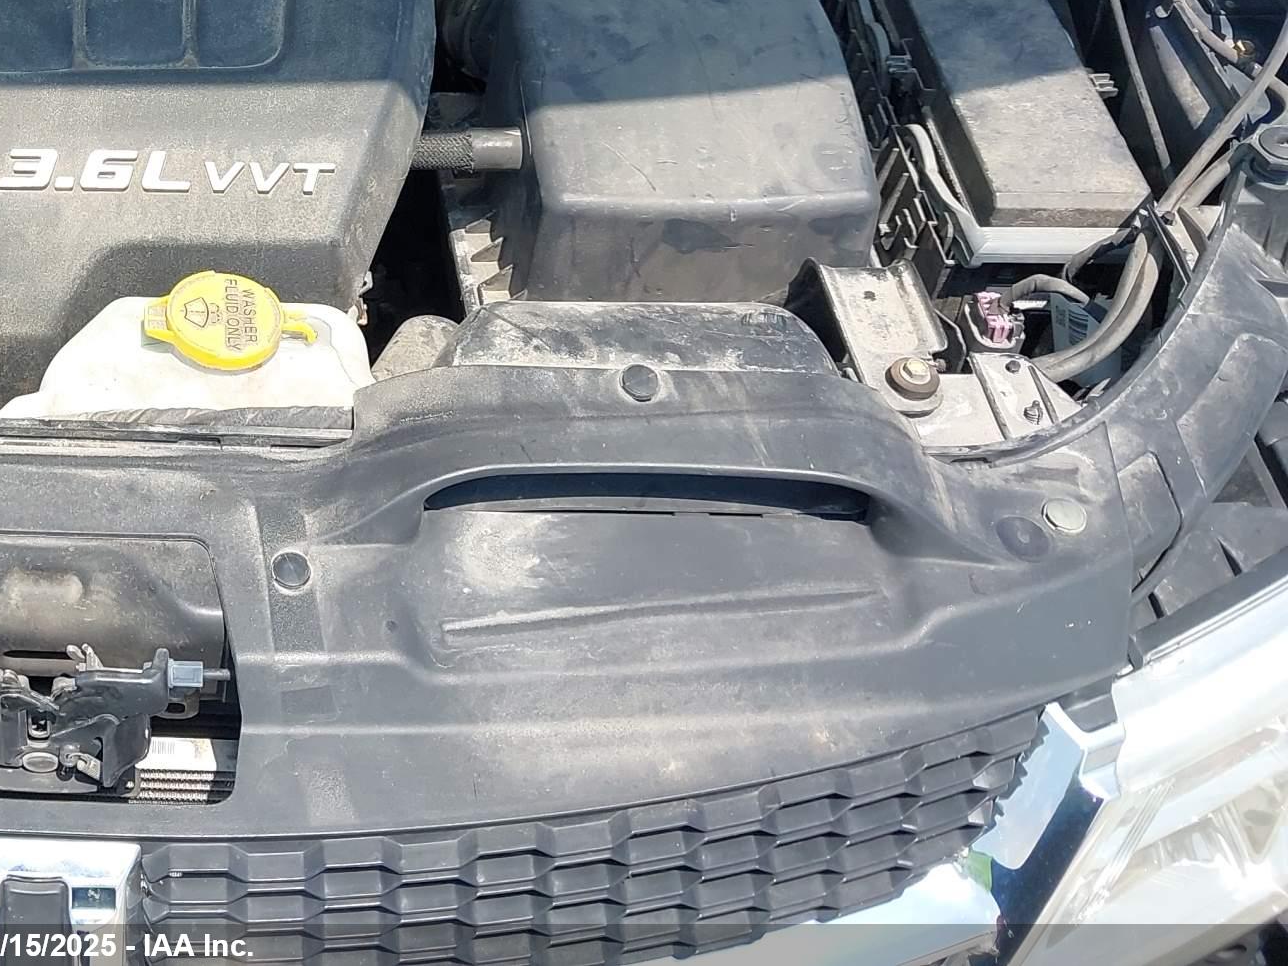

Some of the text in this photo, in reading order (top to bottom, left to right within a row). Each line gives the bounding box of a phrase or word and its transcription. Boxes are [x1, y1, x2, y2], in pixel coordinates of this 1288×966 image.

[204, 160, 337, 196] VVT
[224, 278, 241, 351] FLUID ONLY
[241, 288, 258, 346] WASHER
